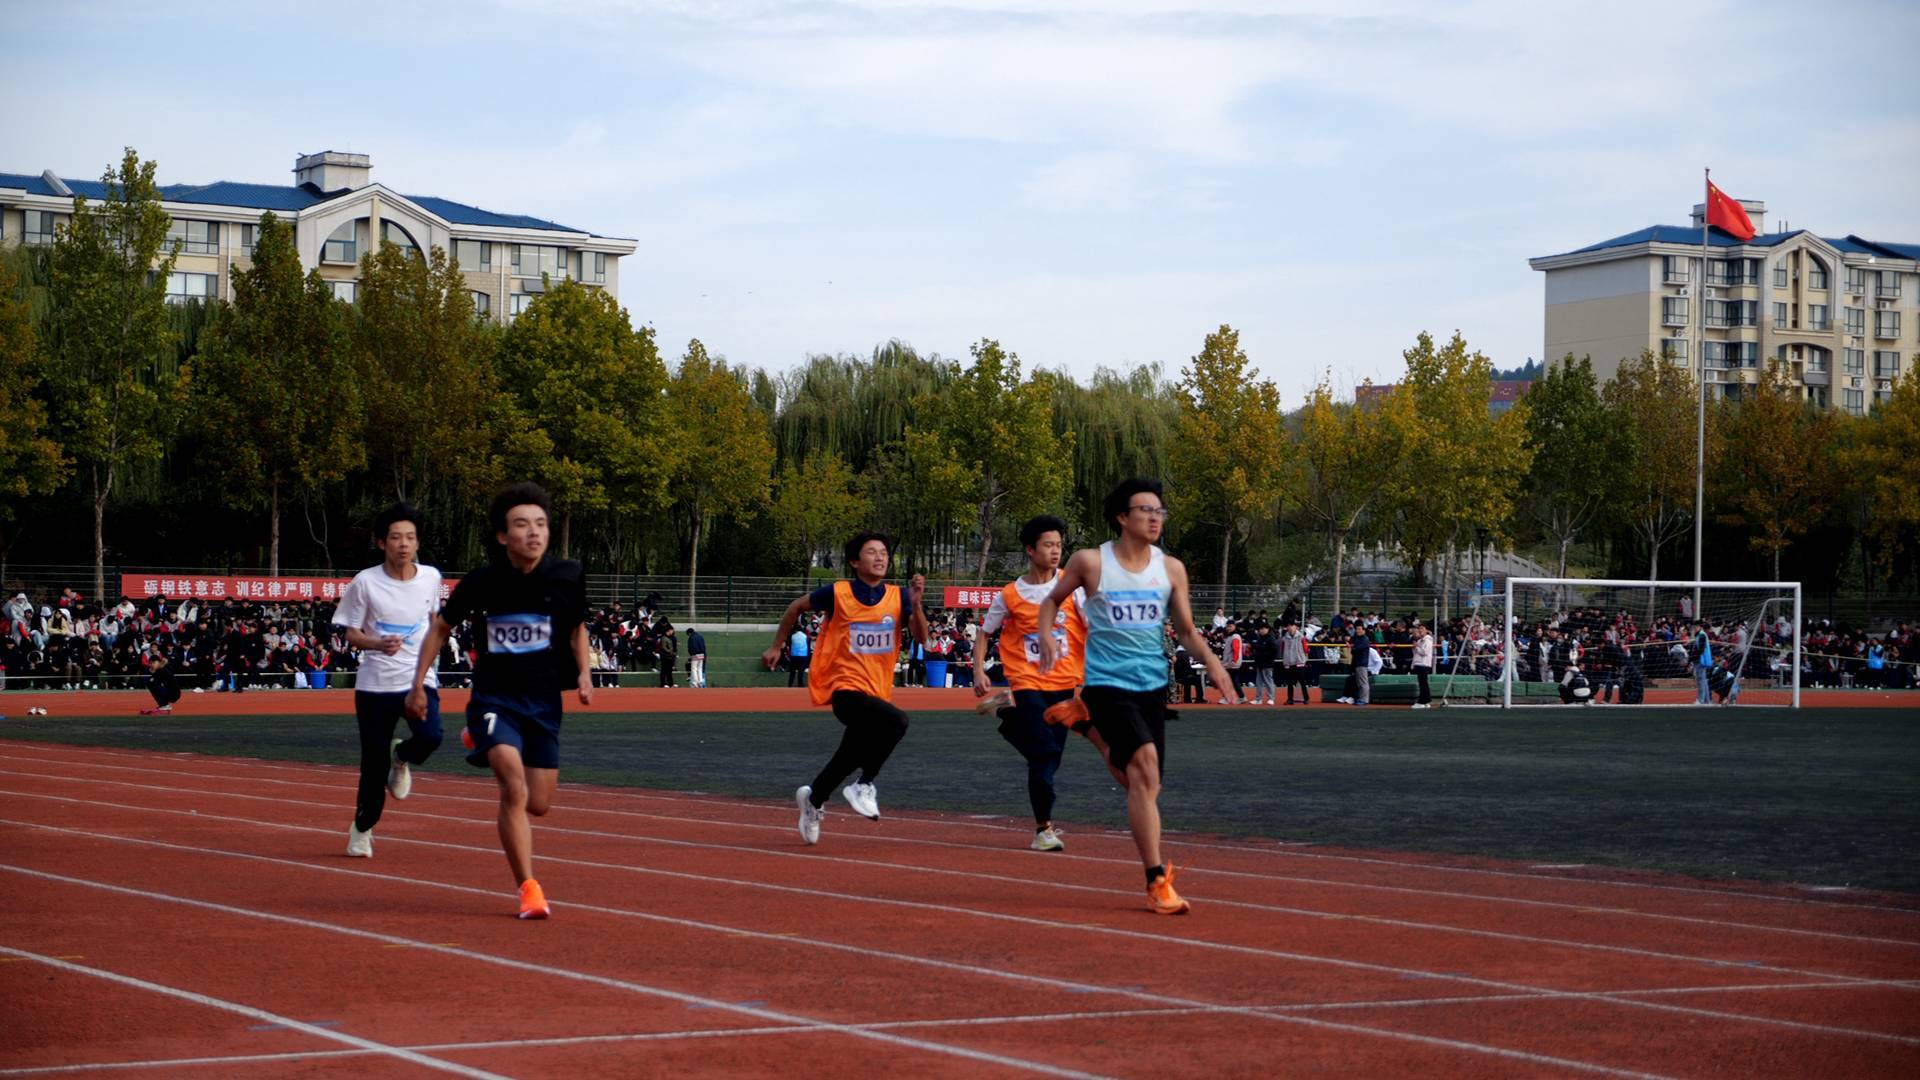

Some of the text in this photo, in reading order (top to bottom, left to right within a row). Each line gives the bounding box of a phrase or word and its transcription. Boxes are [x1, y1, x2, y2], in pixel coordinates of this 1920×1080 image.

[144, 580, 225, 596] 砺钢铁意志
[236, 581, 313, 597] 训纪律严明
[1112, 604, 1158, 621] 0173
[495, 625, 541, 644] 0301
[856, 633, 890, 648] 0011
[483, 711, 498, 736] 7
